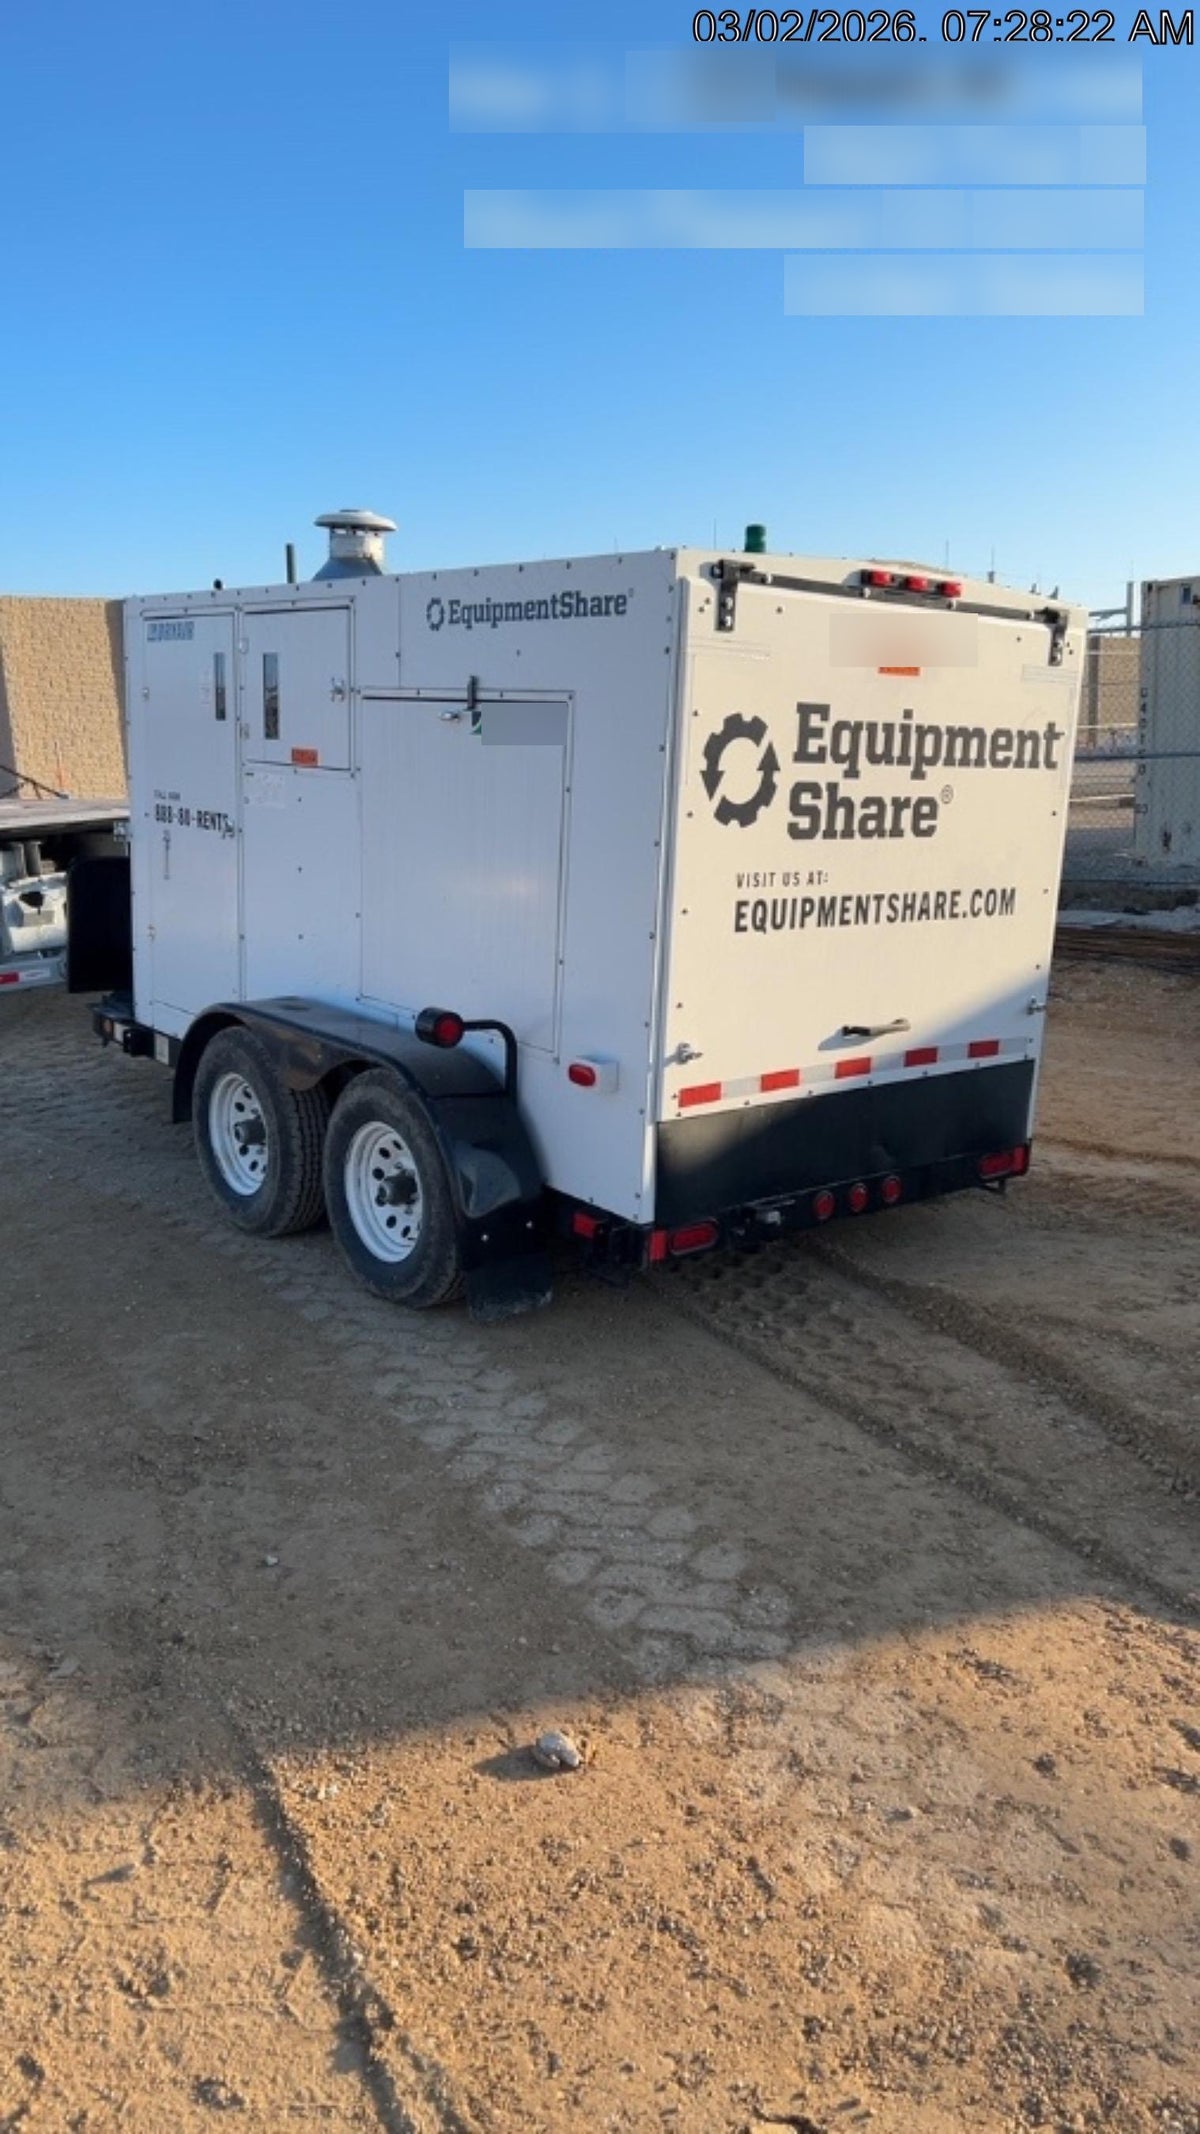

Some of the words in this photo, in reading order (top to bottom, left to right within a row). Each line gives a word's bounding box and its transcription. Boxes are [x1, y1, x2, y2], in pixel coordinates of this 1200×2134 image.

[792, 702, 1065, 780] Equipment
[736, 872, 776, 888] VISIT
[782, 872, 801, 886] US
[806, 871, 828, 886] AT:
[734, 887, 1017, 934] EQUIPMENTSHARE.COM
